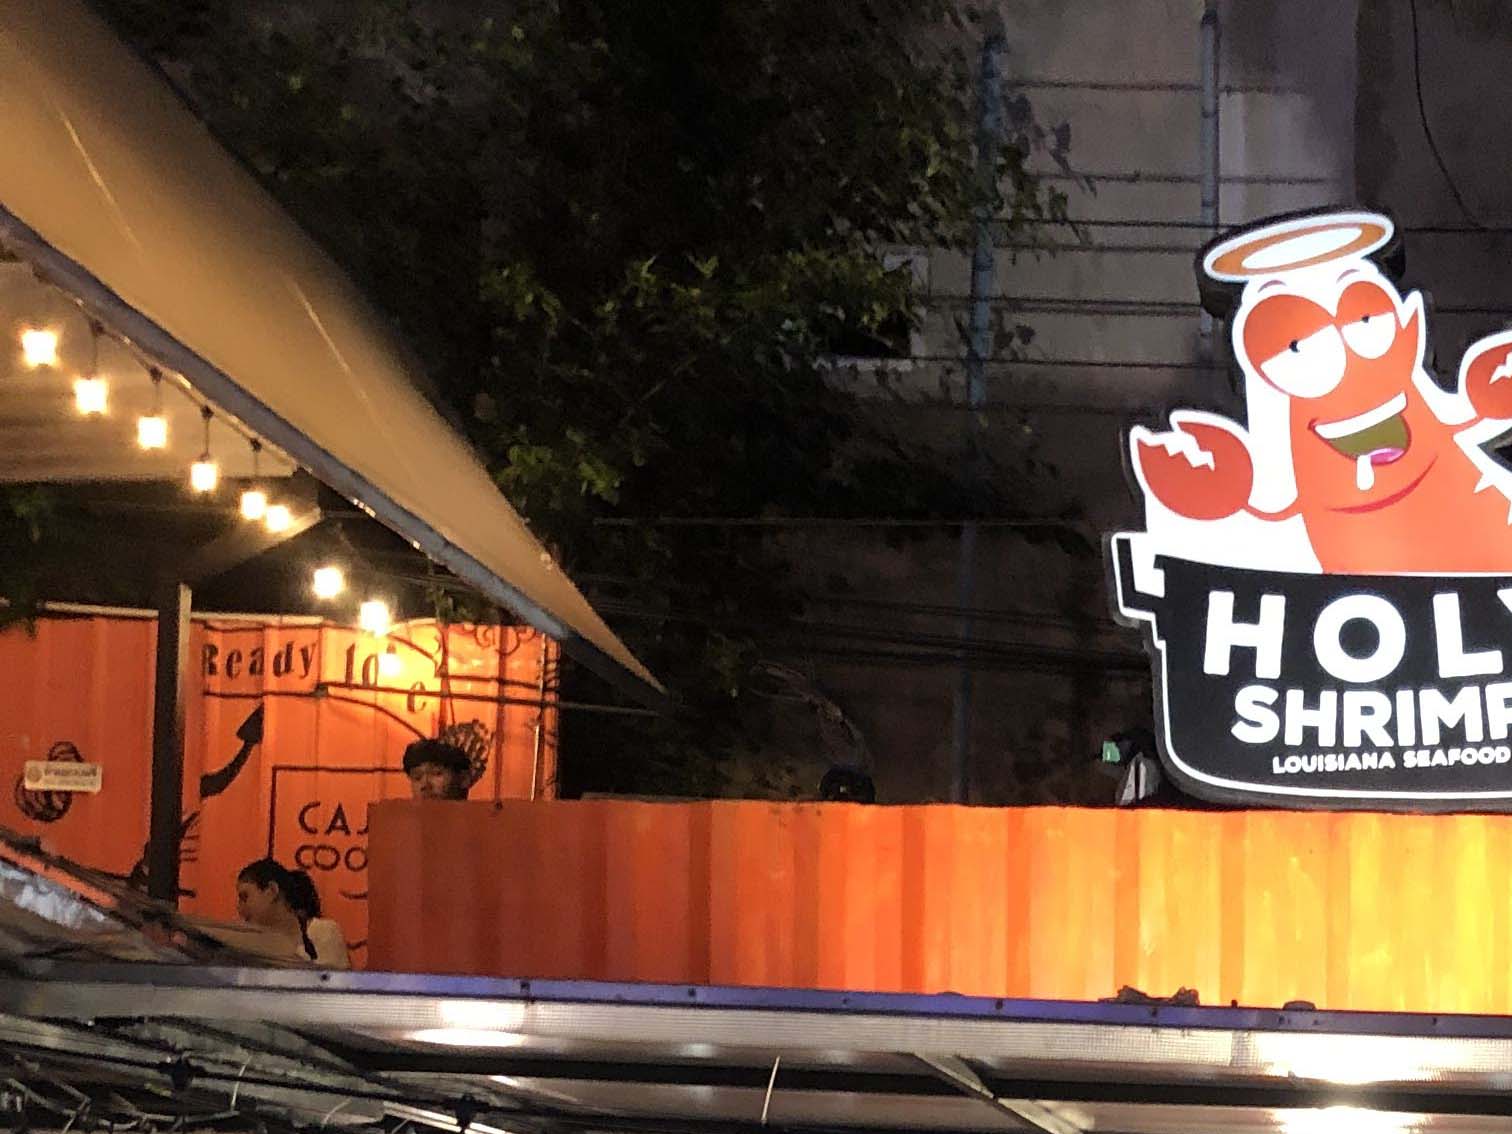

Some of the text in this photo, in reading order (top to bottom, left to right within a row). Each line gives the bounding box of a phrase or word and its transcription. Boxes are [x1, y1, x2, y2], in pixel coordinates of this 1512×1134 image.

[201, 638, 318, 680] Ready
[1272, 746, 1512, 774] LOUISIANA SEAFOOD
